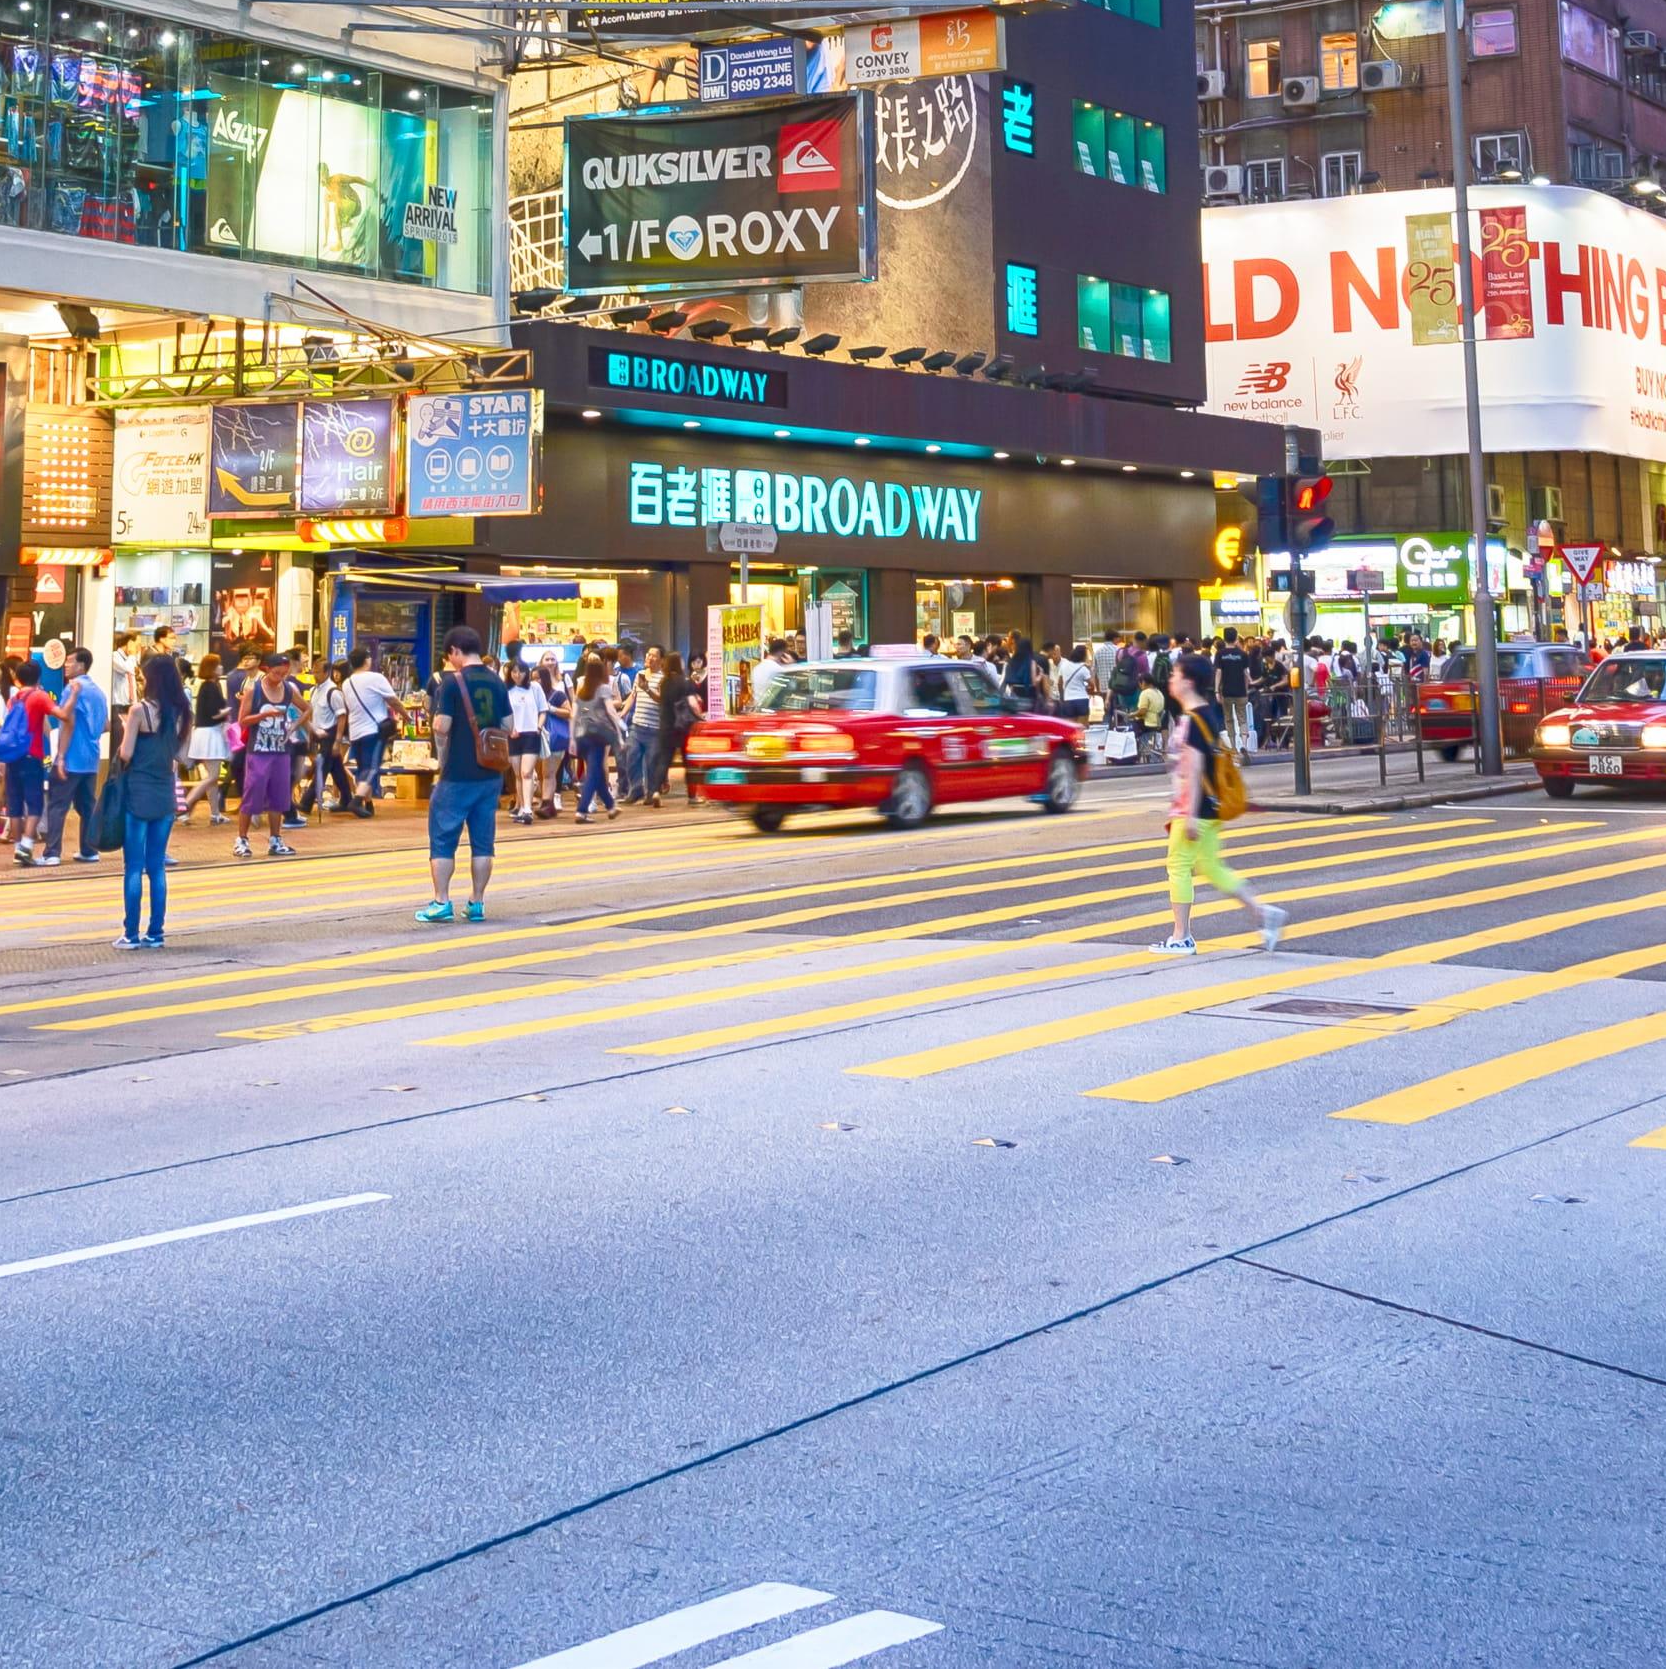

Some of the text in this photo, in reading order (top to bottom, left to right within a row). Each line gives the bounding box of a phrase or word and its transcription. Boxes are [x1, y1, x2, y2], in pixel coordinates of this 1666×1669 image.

[729, 50, 755, 62] Donald
[855, 51, 909, 69] CONVEY
[732, 62, 791, 79] AD HOTLINE
[703, 85, 727, 100] DWL
[731, 75, 793, 93] 9699 2348
[582, 143, 773, 191] QUIKSILVER
[428, 185, 457, 210] NEW
[405, 201, 457, 232] ARRIVAL
[600, 206, 842, 262] 1/F ROXY
[1482, 222, 1531, 268] 25
[1408, 261, 1457, 306] 25
[1487, 270, 1525, 281] Basic Law
[633, 358, 769, 403] BROADWAY
[1635, 366, 1654, 395] BUY
[468, 394, 526, 415] STAR
[1223, 397, 1302, 412] new balance
[1332, 406, 1364, 420] L.F.C.
[468, 419, 526, 437] 十大書坊
[259, 449, 275, 472] 2/F
[337, 460, 382, 482] Hair
[146, 478, 203, 495] 網遊加盟
[630, 462, 983, 543] 百老匯 BROADWAY
[333, 615, 347, 658] 电话
[474, 688, 493, 729] 3
